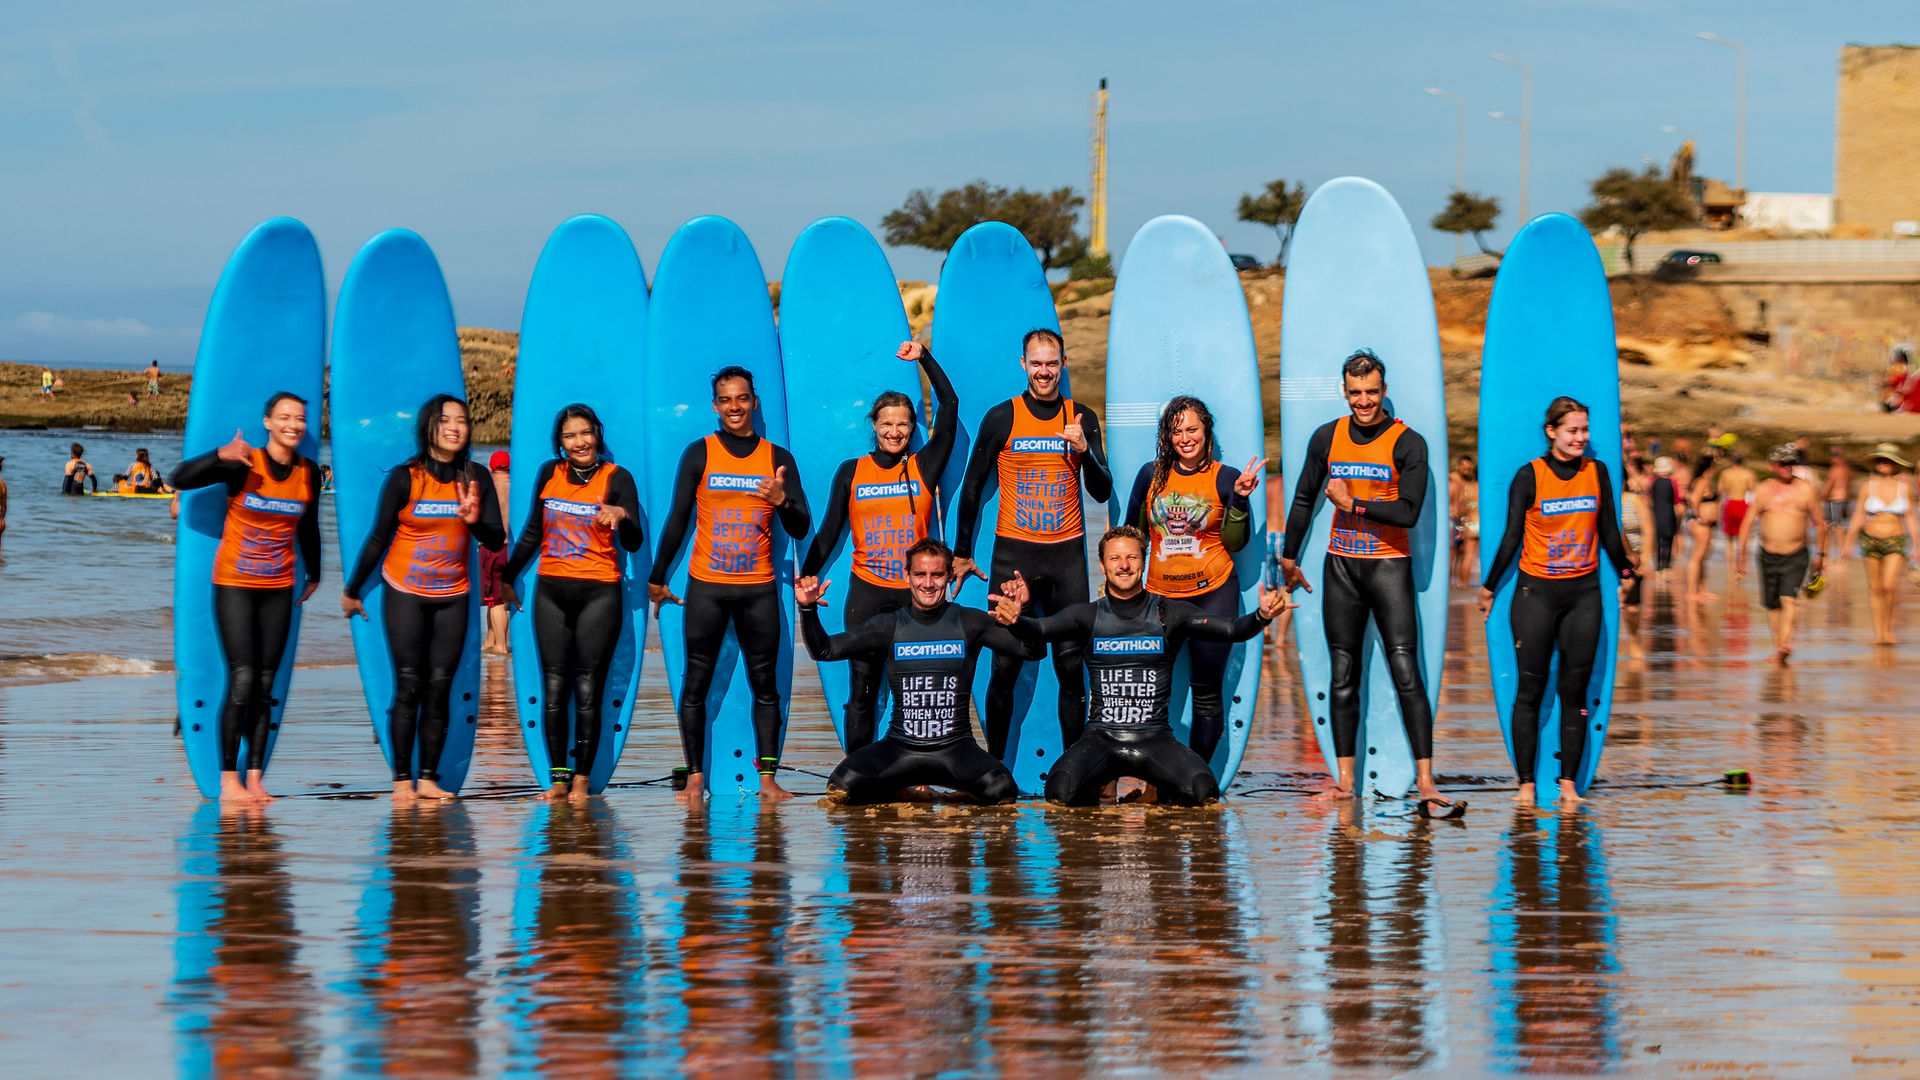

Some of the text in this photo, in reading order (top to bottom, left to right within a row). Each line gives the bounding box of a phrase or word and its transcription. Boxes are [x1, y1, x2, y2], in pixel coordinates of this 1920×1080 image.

[1016, 468, 1070, 482] LIFE IS
[1331, 465, 1389, 479] DECATHLON
[709, 476, 762, 489] DECATHLO
[1016, 481, 1067, 498] BETTER
[414, 503, 458, 514] DECATH
[1016, 497, 1066, 511] WHEN YOU
[712, 508, 764, 522] LIFE IS
[863, 514, 915, 530] LIFE IS
[1015, 508, 1066, 532] SURF
[712, 522, 761, 538] BETTER
[1547, 530, 1576, 543] LIFE
[864, 529, 915, 546] BETTER
[711, 539, 760, 552] WHEN YOU
[866, 546, 911, 559] WHEN YO
[1332, 536, 1381, 555] SURF
[709, 551, 759, 573] SURF
[865, 560, 908, 580] SUR
[897, 644, 962, 657] DECATHLON
[1096, 640, 1161, 651] DECATHLON
[902, 676, 957, 690] LIFE IS
[1100, 669, 1157, 683] LIFE IS
[1101, 683, 1157, 697] BETTER
[902, 690, 956, 706] BETTER
[1102, 697, 1155, 708] WHEN YOU
[902, 708, 955, 720] WHEN YOU
[1101, 706, 1154, 723] SURF
[902, 719, 954, 738] SURF
